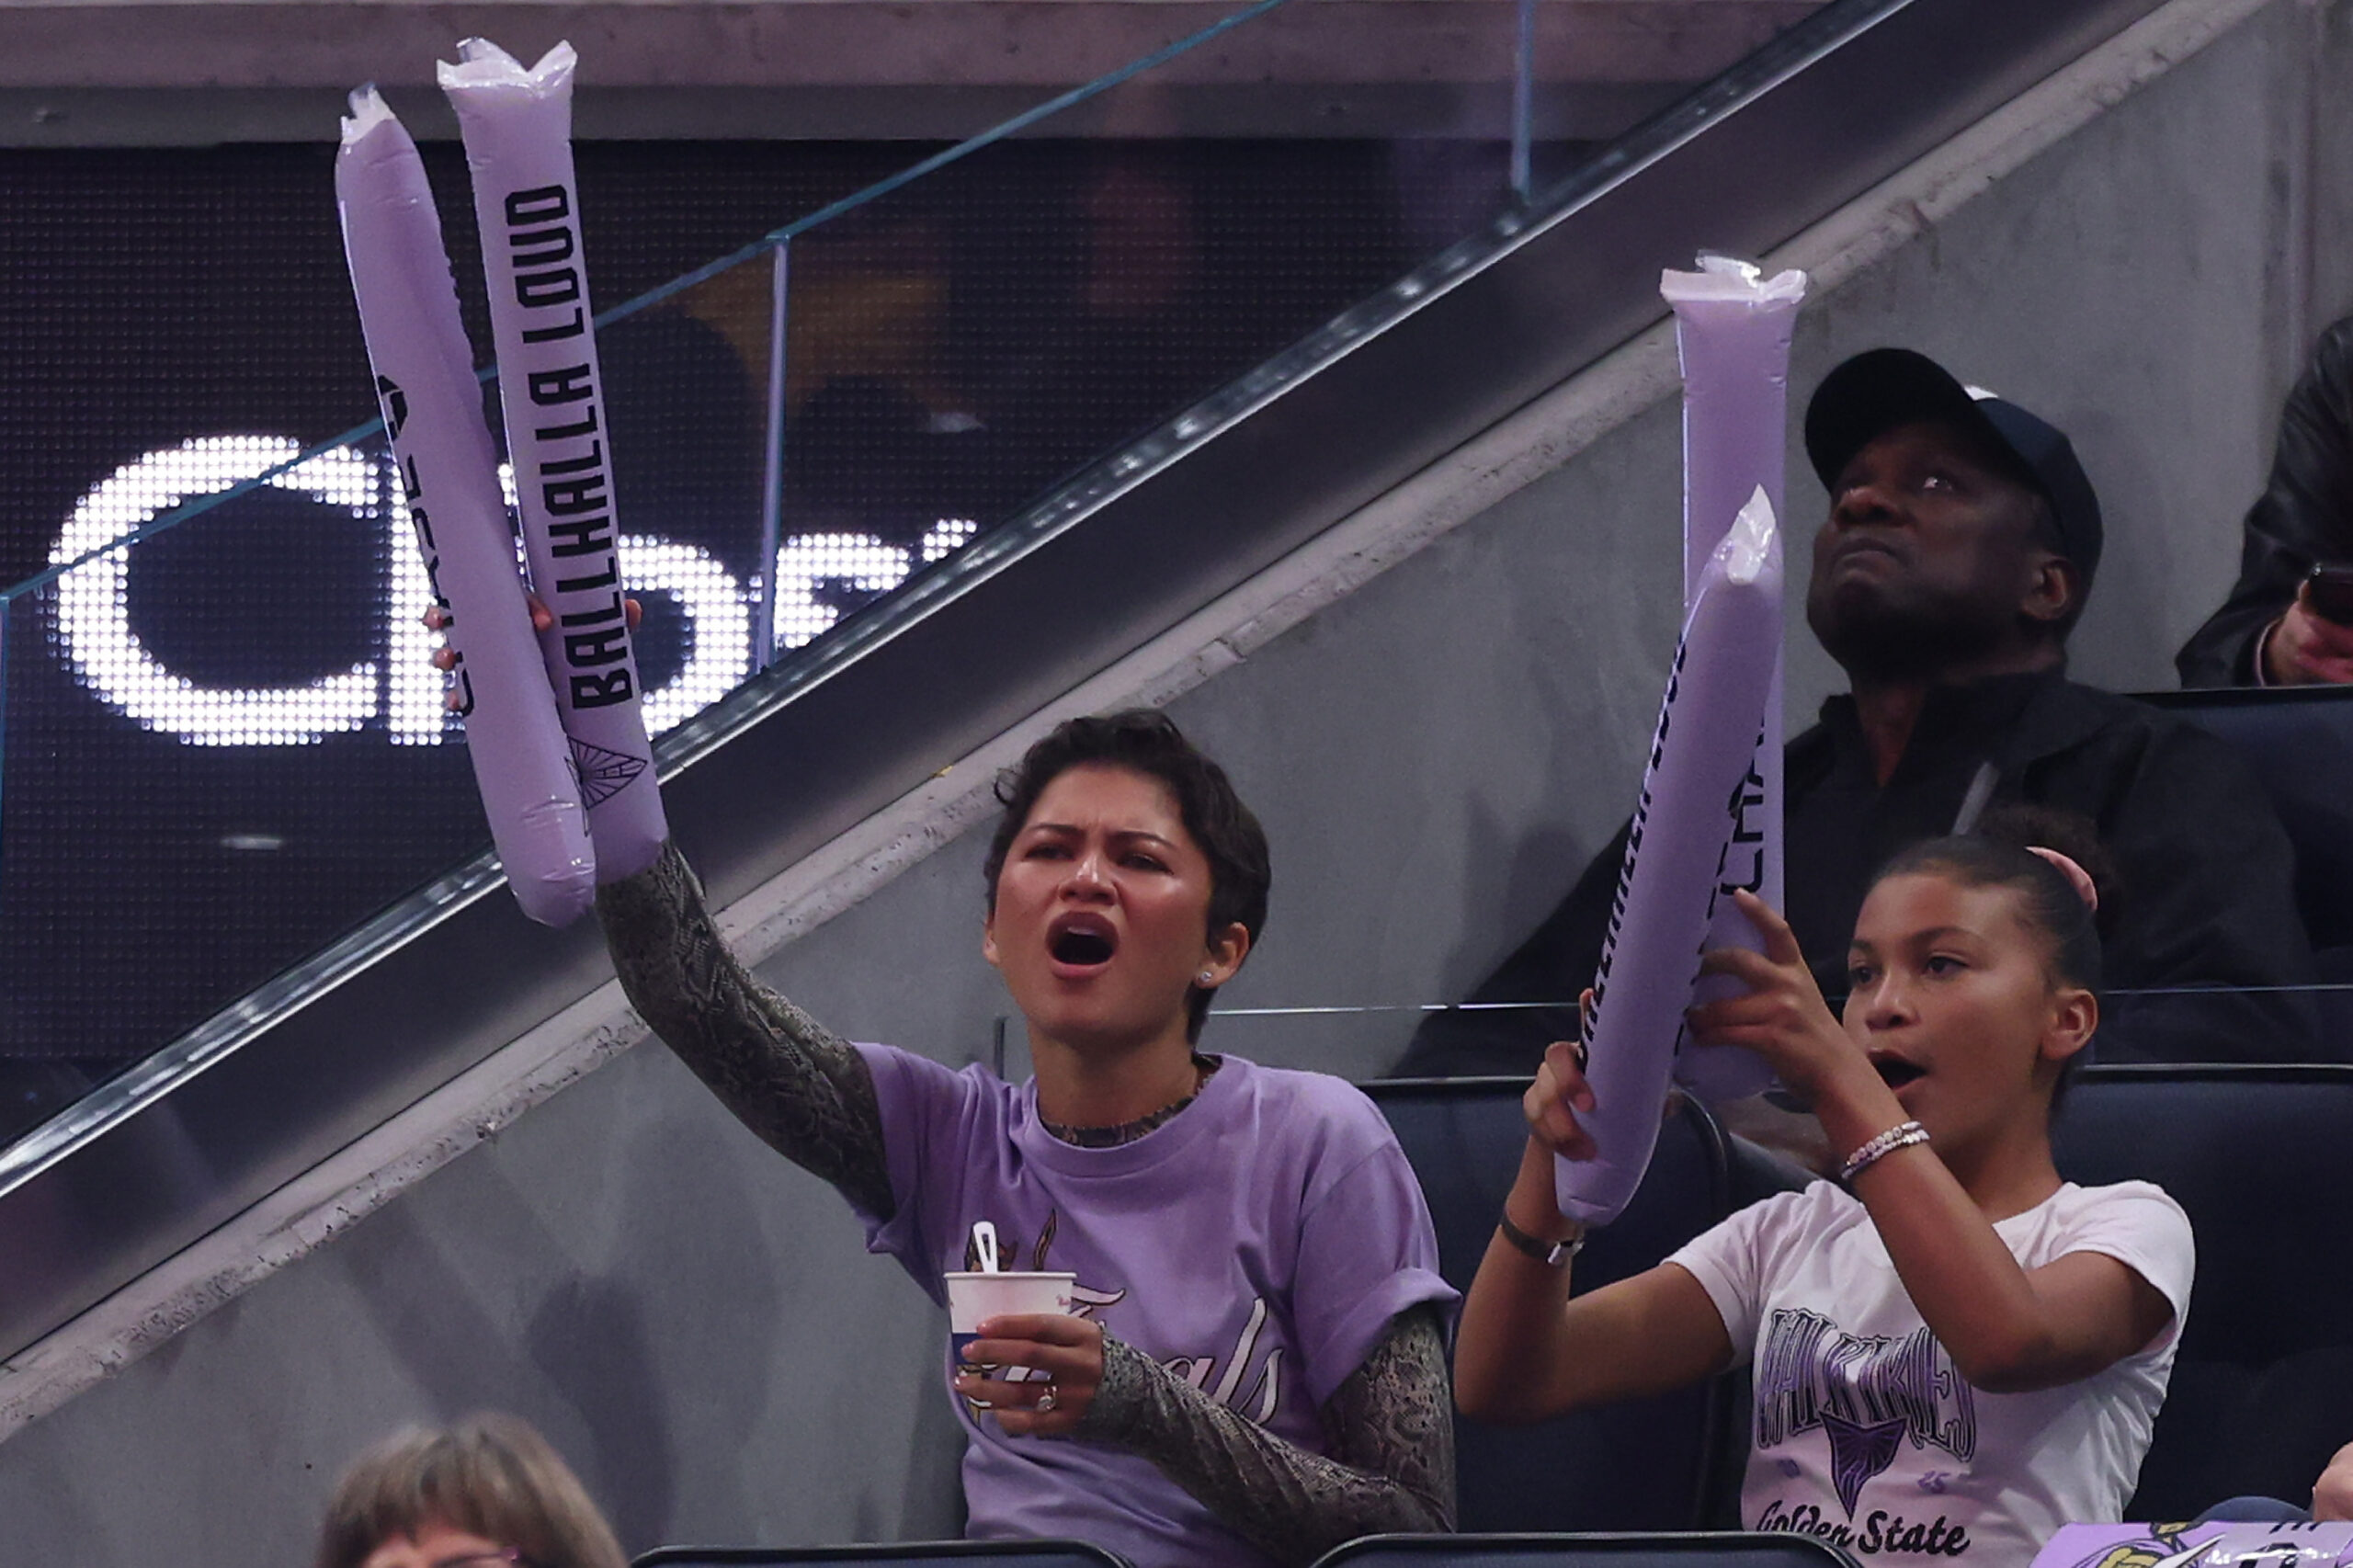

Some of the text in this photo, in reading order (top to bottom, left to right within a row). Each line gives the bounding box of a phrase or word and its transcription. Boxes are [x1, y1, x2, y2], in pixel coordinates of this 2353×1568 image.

[506, 185, 633, 710] BALLHALLA LOUD
[1858, 1510, 1971, 1556] State
